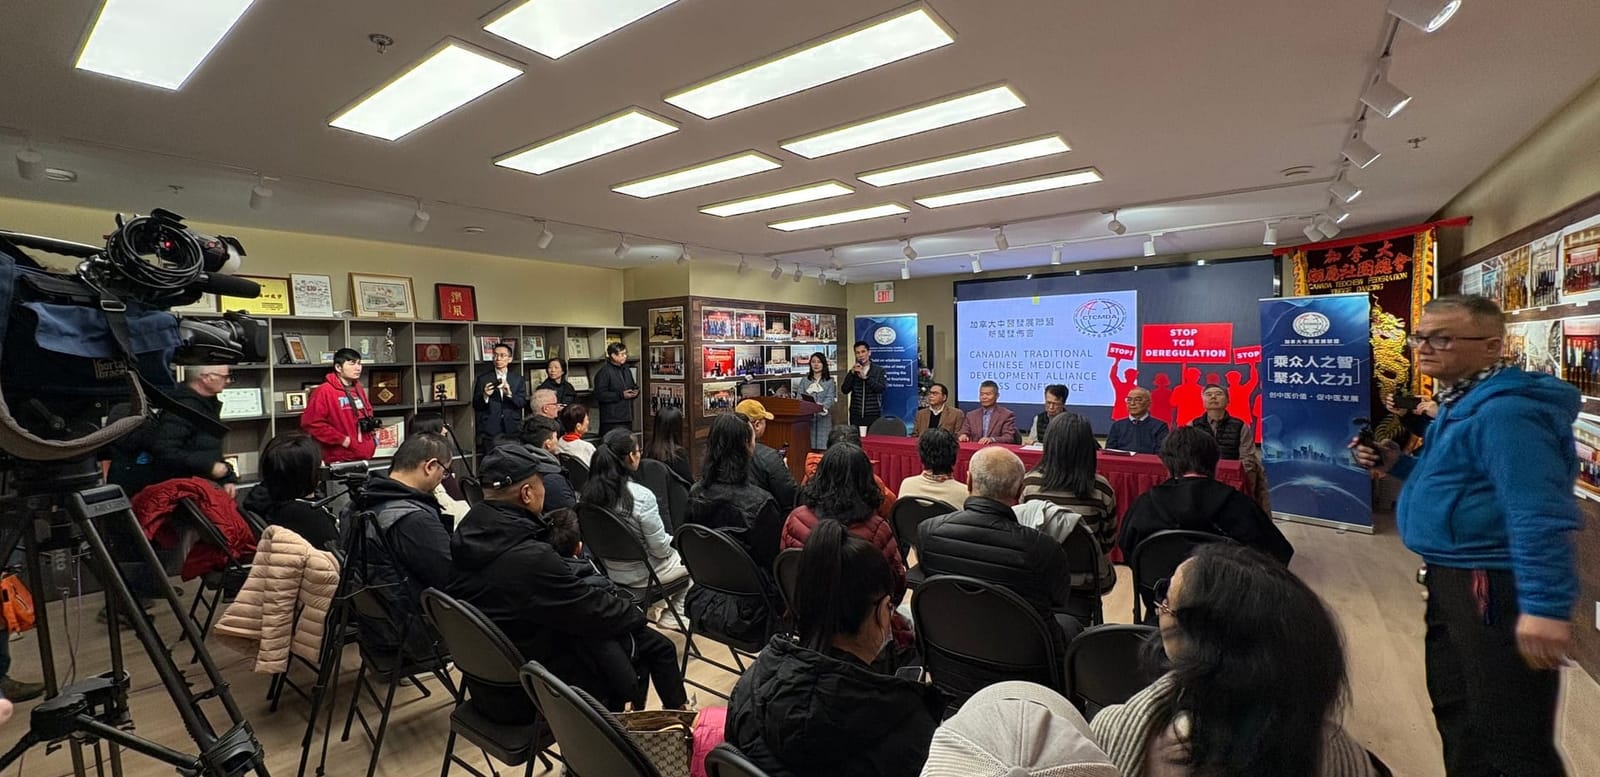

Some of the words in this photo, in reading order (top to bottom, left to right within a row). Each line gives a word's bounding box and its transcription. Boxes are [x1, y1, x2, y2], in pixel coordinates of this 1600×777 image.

[1323, 240, 1394, 264] 加拿大
[1309, 282, 1332, 290] CANADA
[1368, 272, 1408, 284] FEDERATION
[1356, 283, 1384, 293] DANCING
[1169, 329, 1198, 337] STOP
[1172, 339, 1194, 347] TCM
[969, 350, 1017, 359] CANADIAN
[1024, 349, 1093, 358] TRADITIONAL
[1110, 347, 1133, 356] STOP!
[1145, 349, 1226, 358] DEREGULATION
[982, 361, 1024, 369] CHINESE
[1030, 361, 1080, 369] MEDICINE
[1273, 355, 1353, 369] 乘众人之智
[970, 371, 1040, 380] DEVELOPMENT
[1046, 371, 1097, 381] ALLIANCE
[1273, 371, 1353, 386] 聚众人之力
